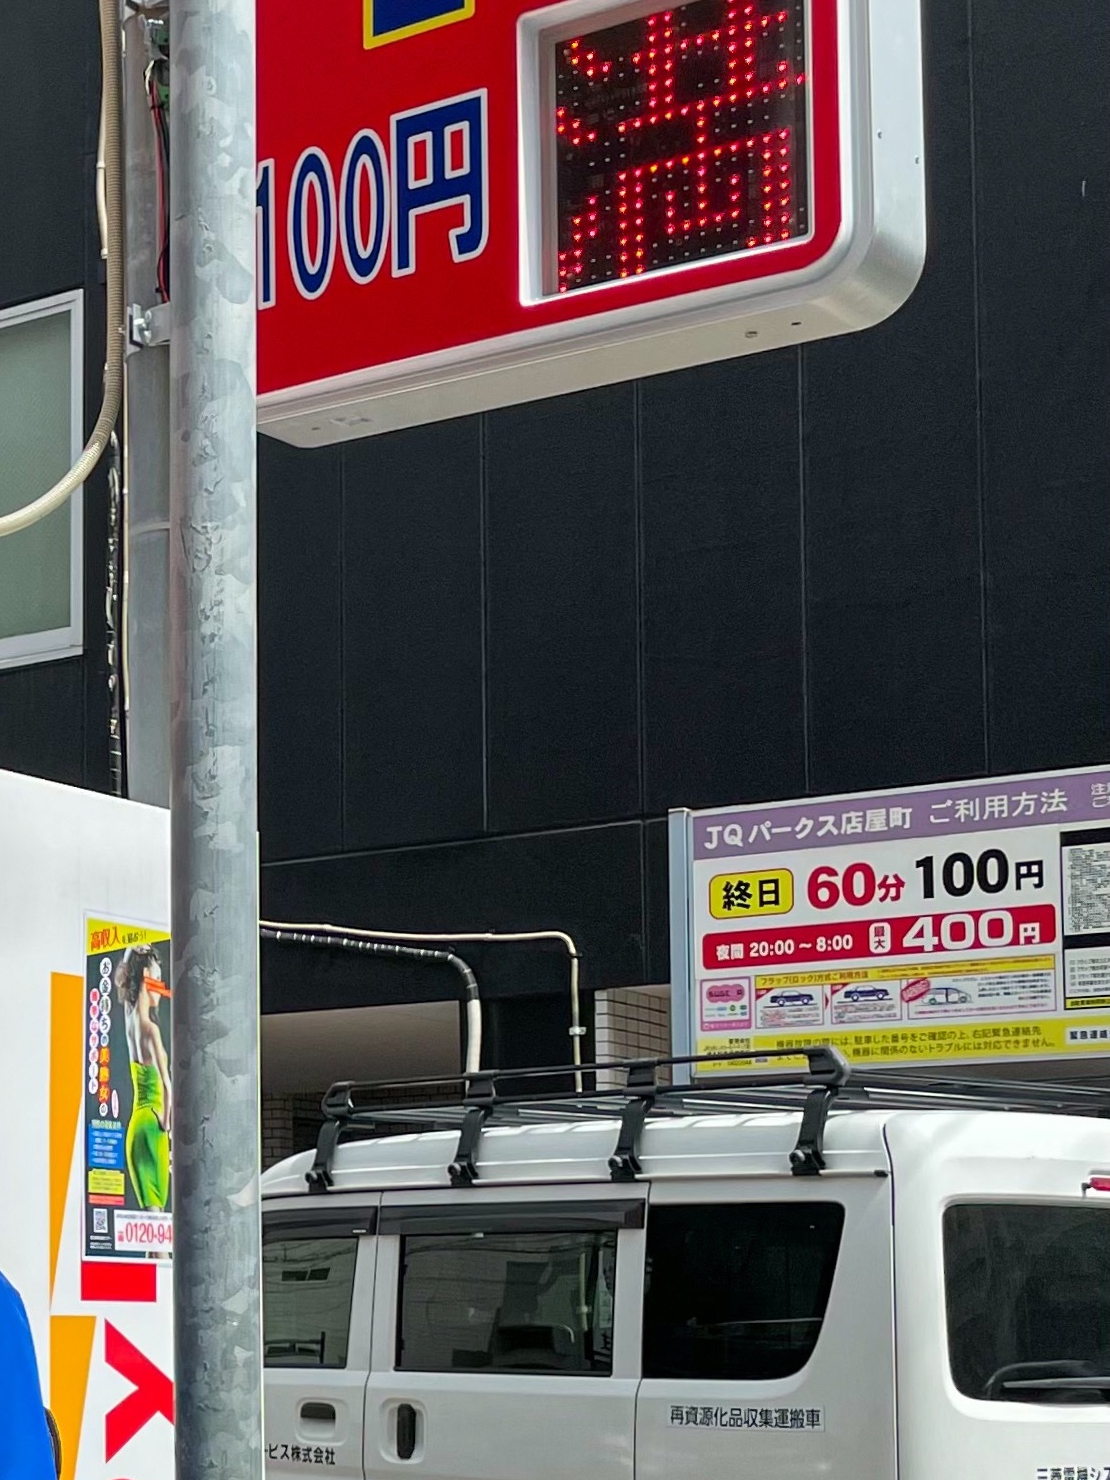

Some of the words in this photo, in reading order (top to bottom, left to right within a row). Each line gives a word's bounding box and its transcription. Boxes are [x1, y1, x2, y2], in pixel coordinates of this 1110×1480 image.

[256, 88, 488, 310] 100円
[704, 807, 912, 850] JQパークス店屋町
[928, 788, 1068, 824] ご利用方法
[722, 878, 781, 911] 終日
[807, 862, 905, 909] 60分
[916, 848, 1044, 898] 100円
[716, 942, 744, 960] 夜間
[902, 909, 1040, 952] 400円
[670, 1405, 822, 1430] 再資源化品収集運搬車
[265, 1444, 336, 1465] ビス株式会社
